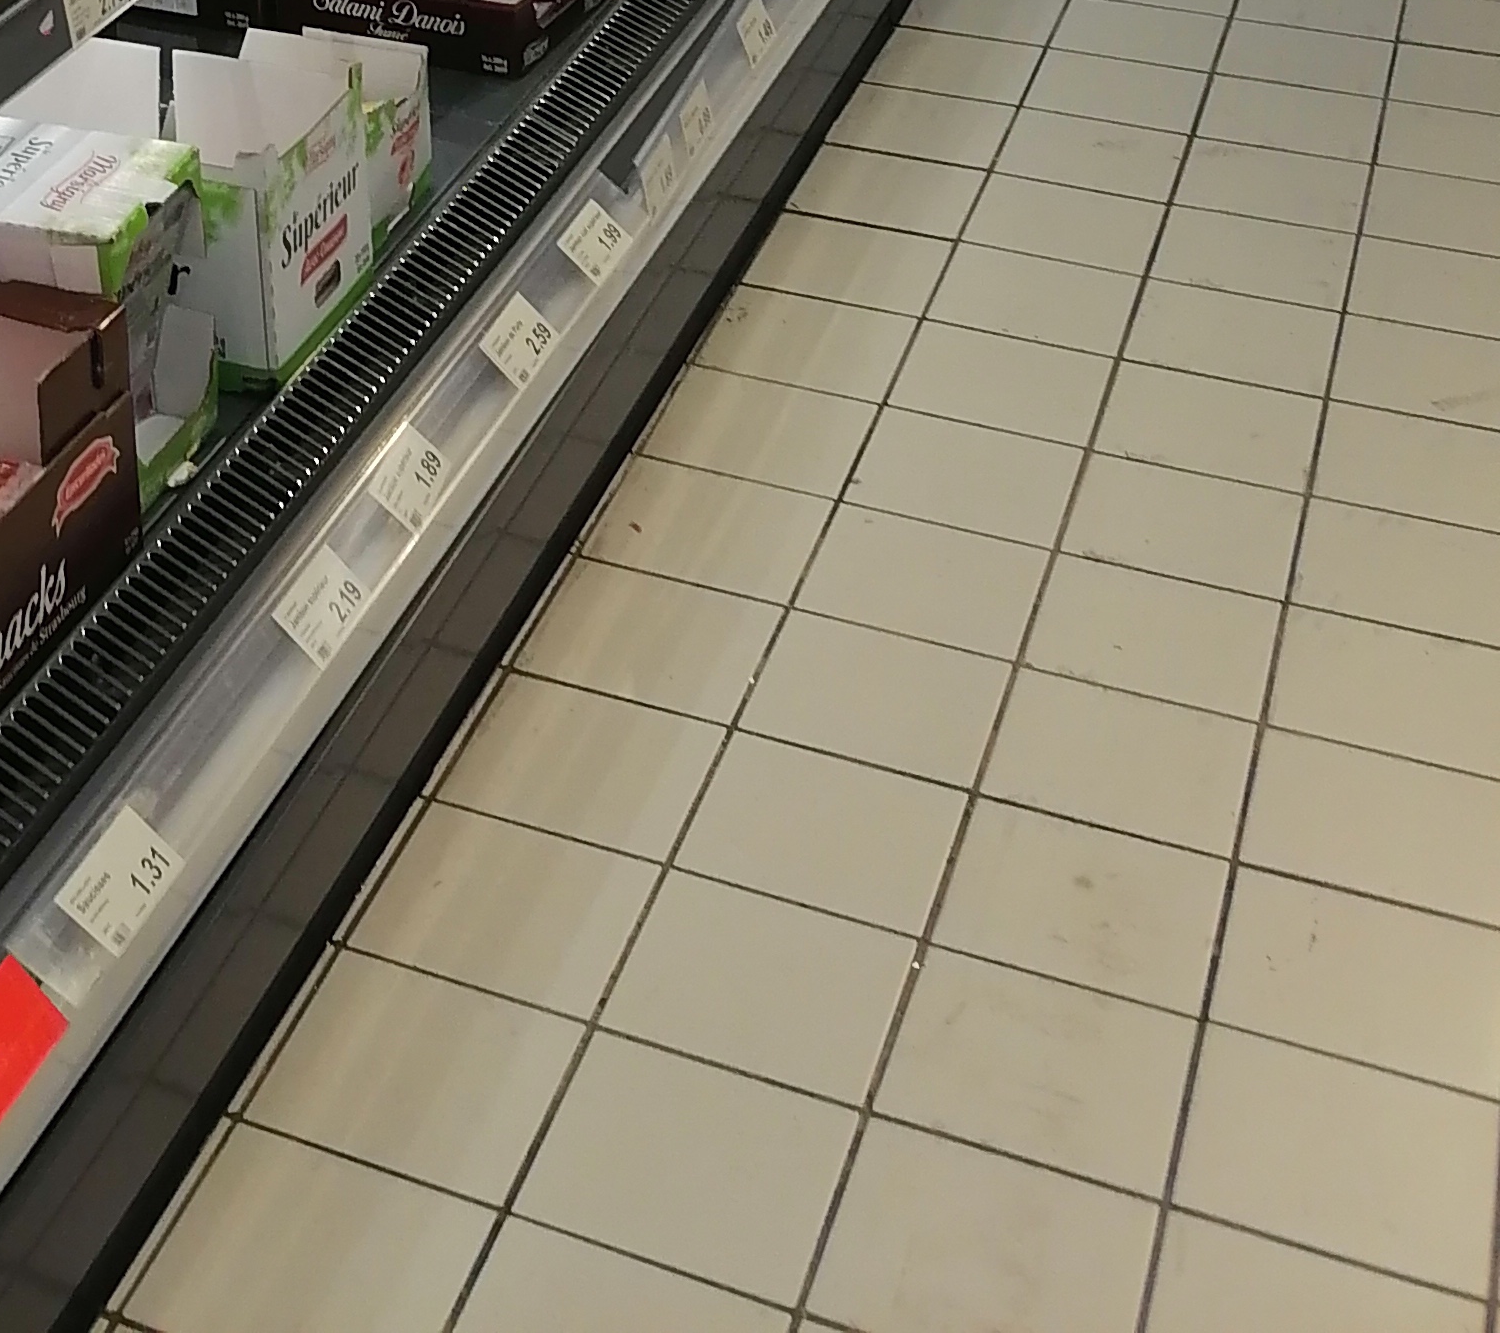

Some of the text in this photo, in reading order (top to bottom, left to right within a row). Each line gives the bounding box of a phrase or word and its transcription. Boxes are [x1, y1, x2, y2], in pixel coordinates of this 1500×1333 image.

[280, 161, 361, 272] Supérieur
[597, 222, 623, 252] 1.99
[525, 321, 552, 357] 2.59
[414, 449, 445, 490] 1.89
[327, 580, 364, 627] 2.19
[130, 845, 172, 895] 1.31
